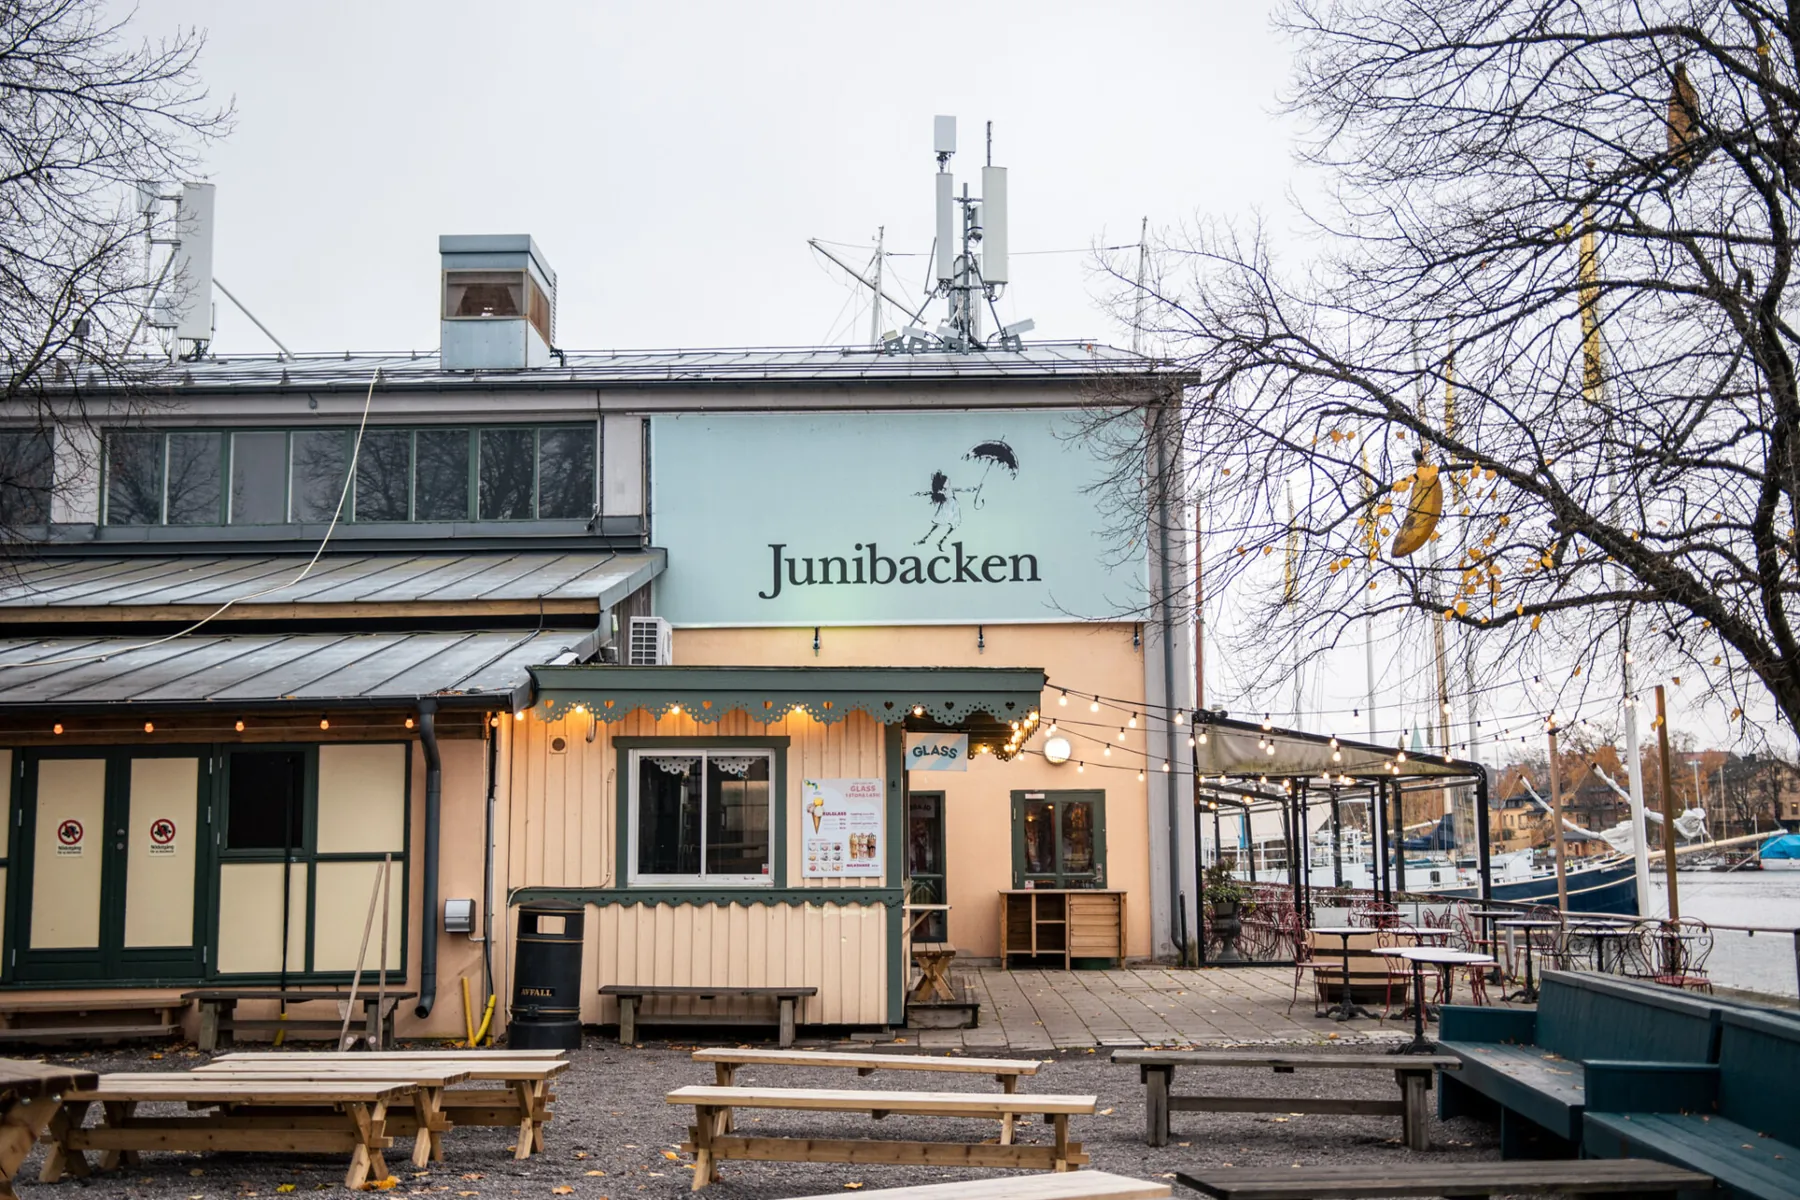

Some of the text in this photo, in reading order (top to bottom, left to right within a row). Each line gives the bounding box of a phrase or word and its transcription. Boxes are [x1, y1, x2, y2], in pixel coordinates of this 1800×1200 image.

[758, 541, 1042, 600] Junibacken
[912, 744, 958, 759] GLASS
[521, 988, 552, 997] AVFALL
